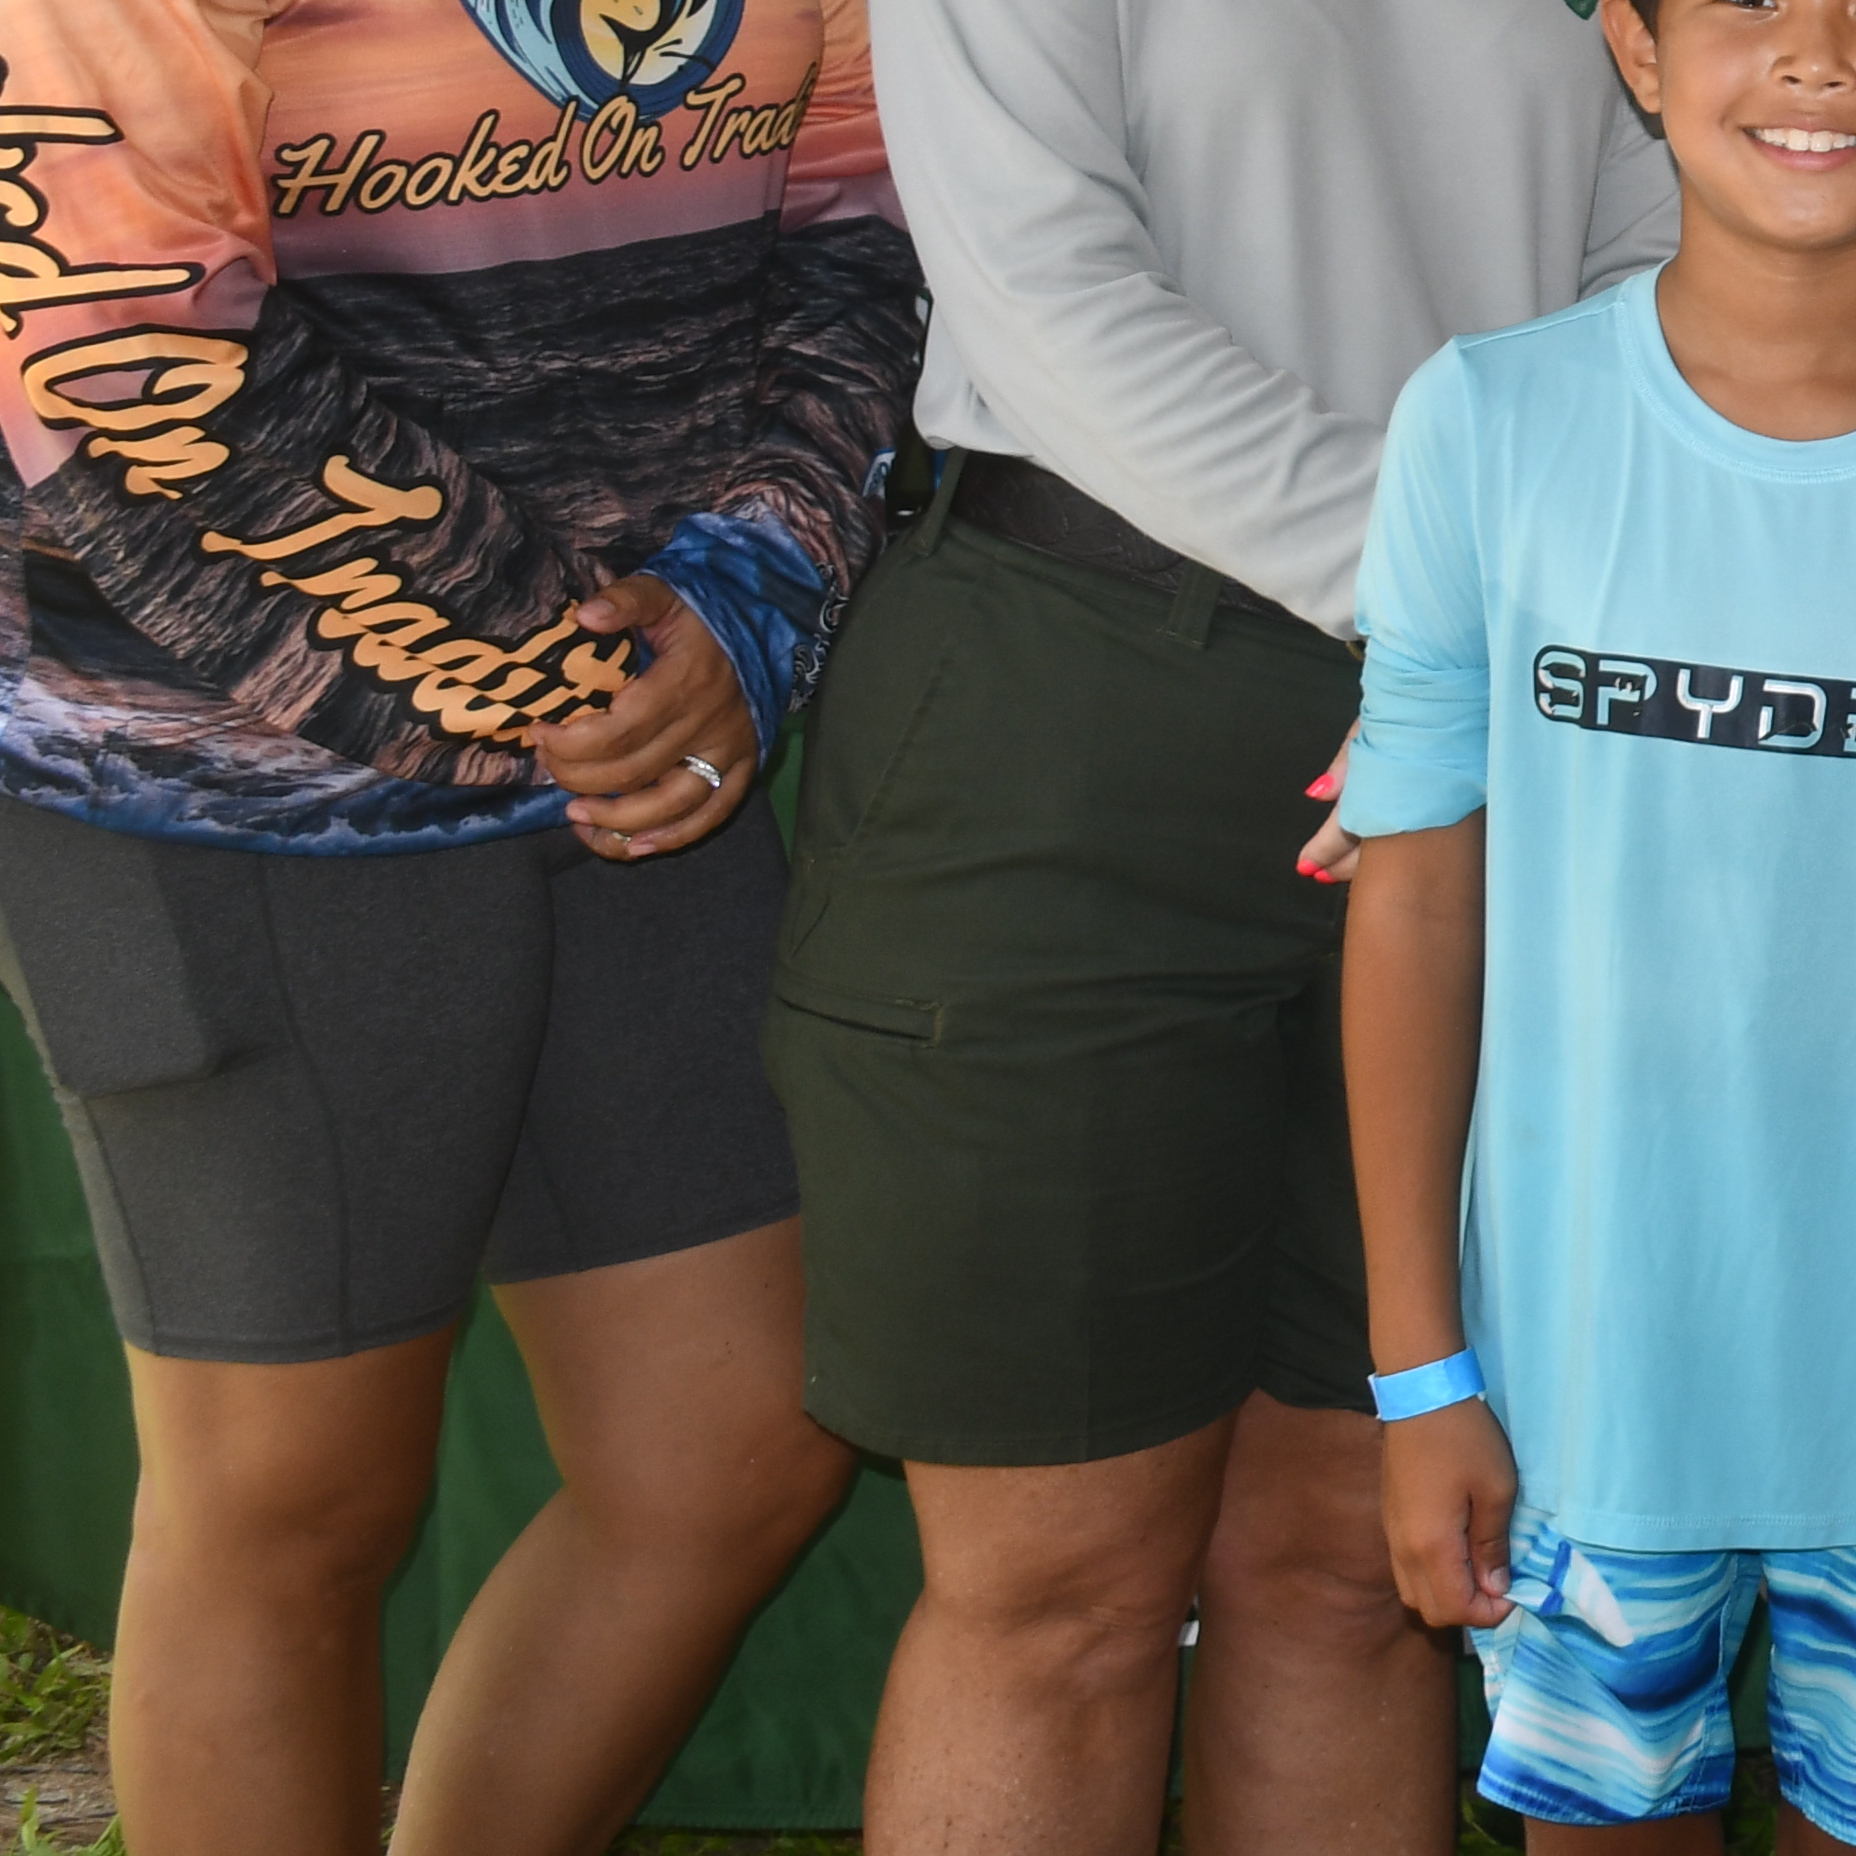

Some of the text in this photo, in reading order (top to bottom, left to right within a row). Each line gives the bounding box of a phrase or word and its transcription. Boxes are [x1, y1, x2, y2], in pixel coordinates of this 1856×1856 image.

[273, 108, 577, 218] Hooked
[580, 93, 665, 183] On
[22, 328, 248, 501] On
